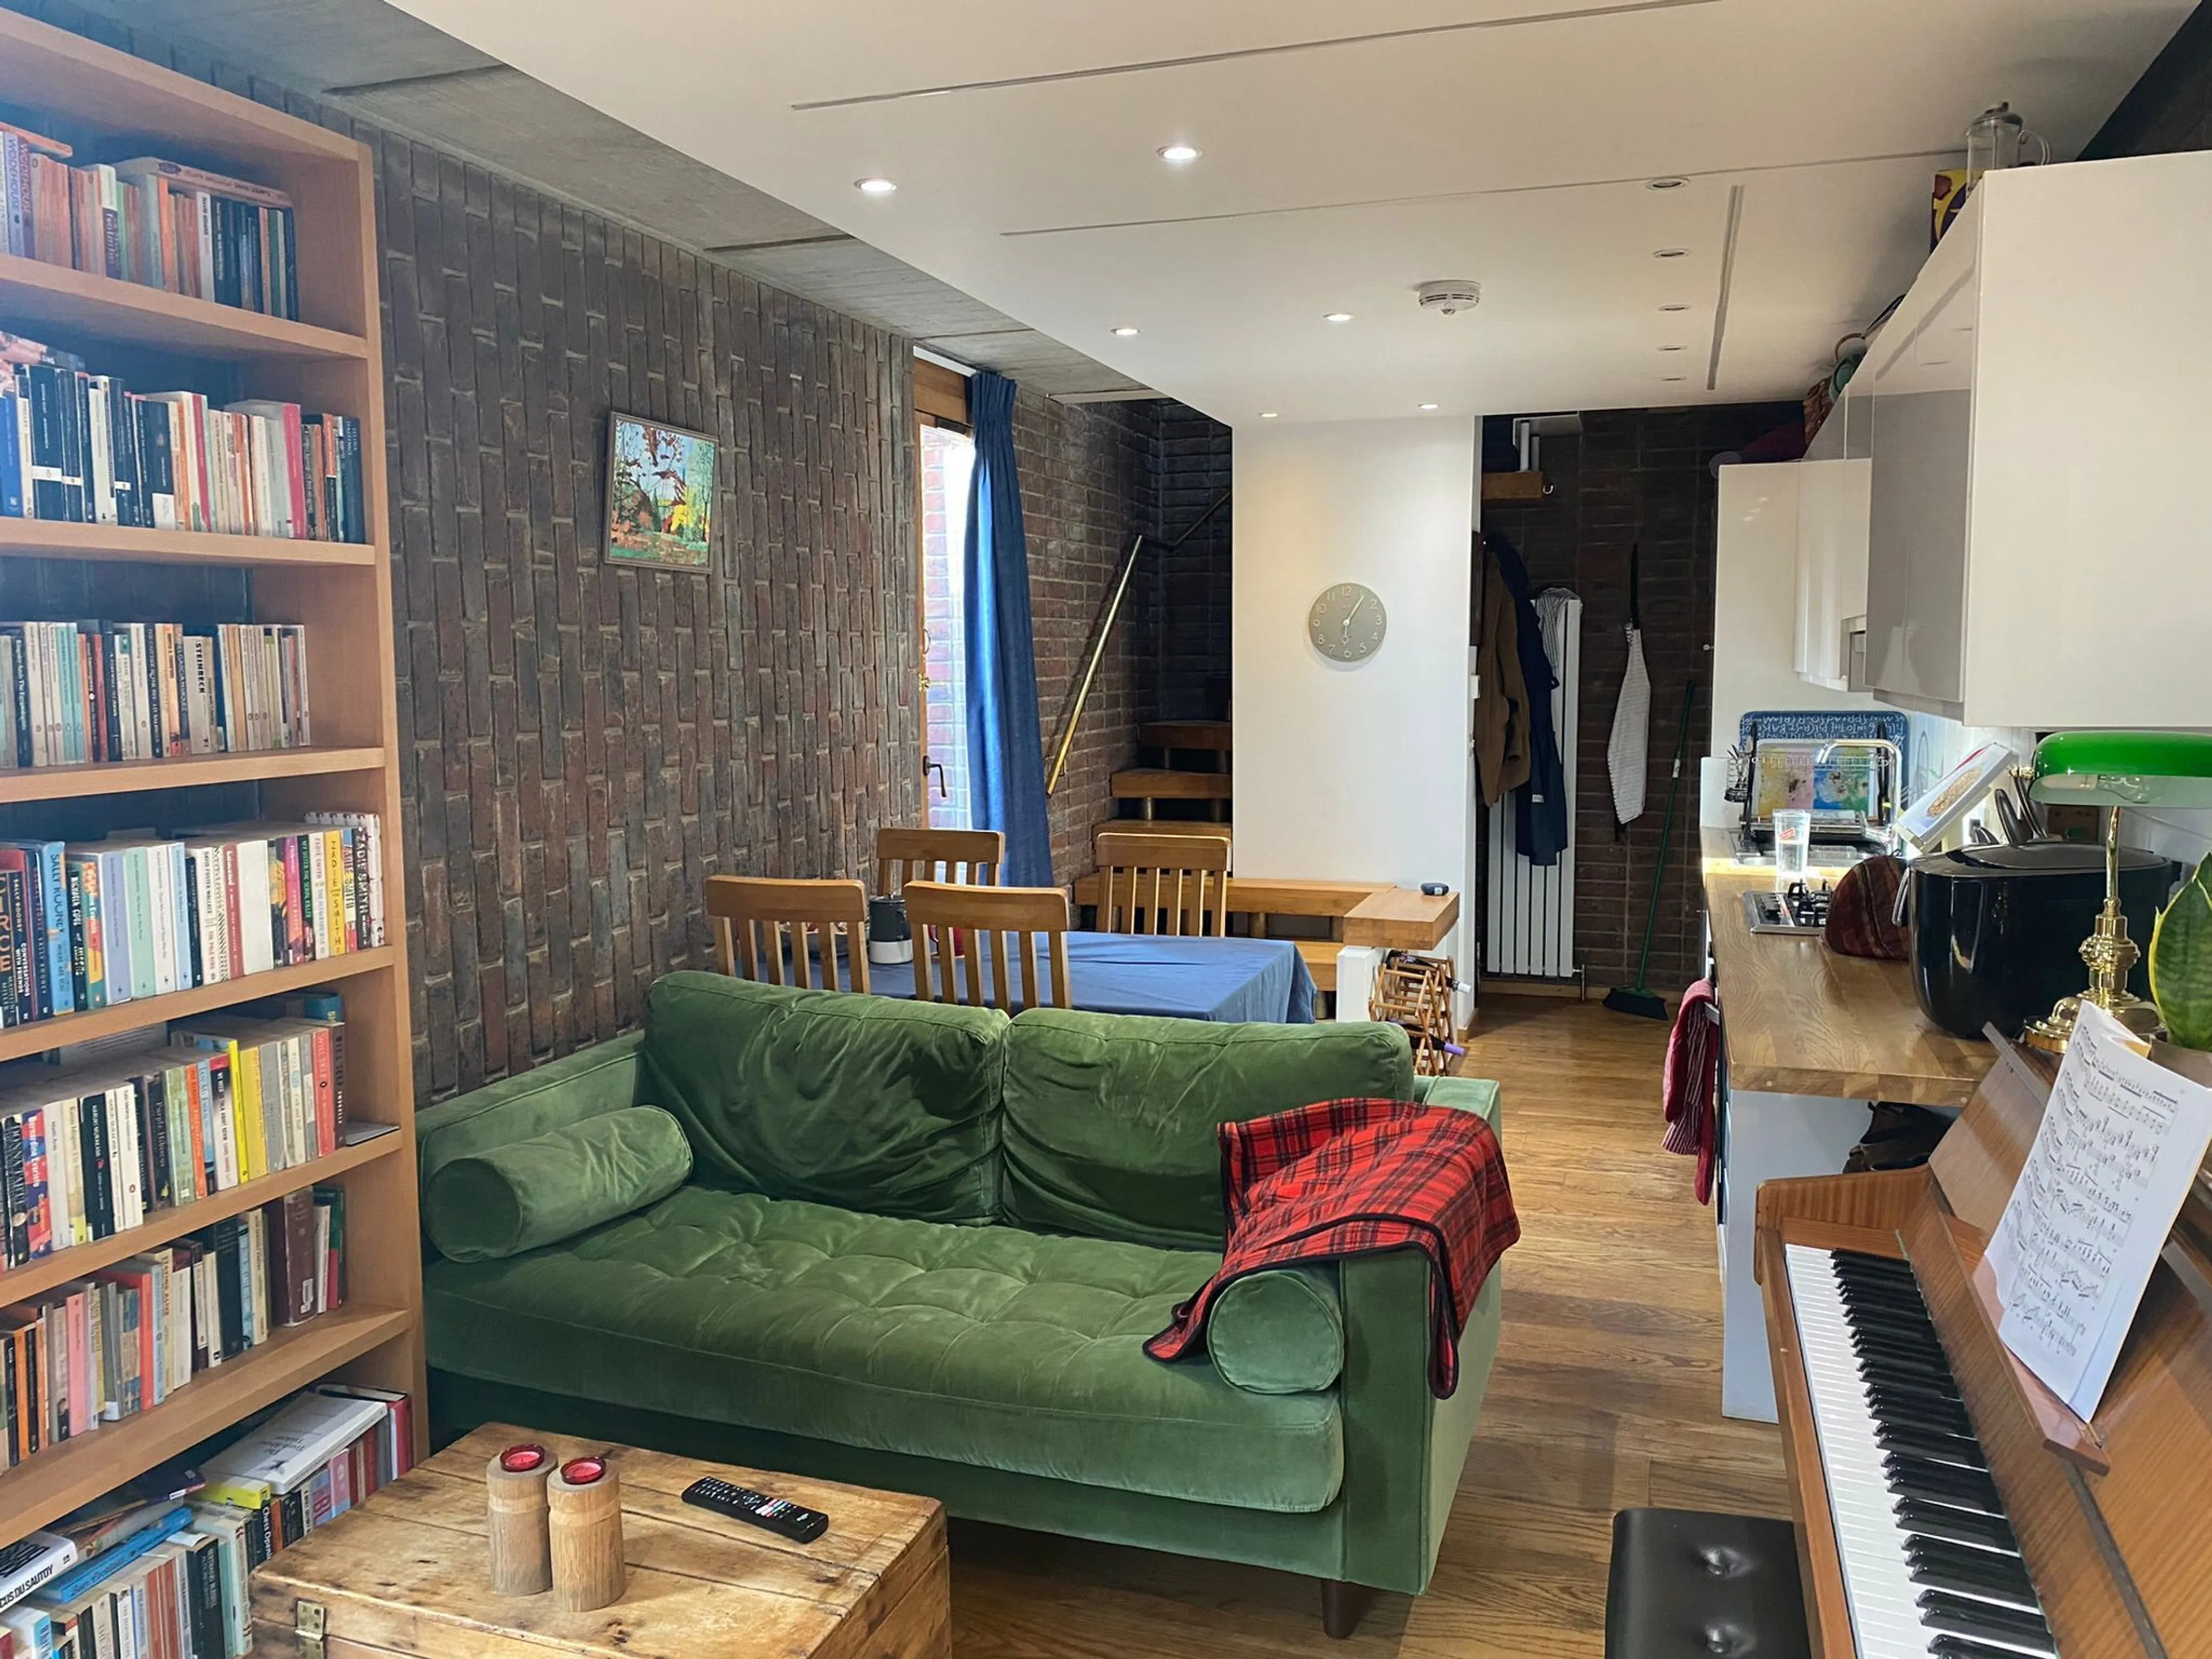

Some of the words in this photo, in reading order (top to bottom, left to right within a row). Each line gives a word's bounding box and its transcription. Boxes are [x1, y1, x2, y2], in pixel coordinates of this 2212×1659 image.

[8, 138, 21, 209] WODEHOUSE
[1327, 592, 1335, 601] 11
[1341, 586, 1352, 597] 12
[1370, 599, 1378, 609] 2
[1316, 603, 1327, 615] 10
[1375, 615, 1382, 625] 3
[1317, 634, 1325, 645] 8
[1329, 644, 1335, 654] 7
[1359, 642, 1366, 653] 5
[1372, 632, 1378, 641] 4
[1344, 649, 1352, 658] 6
[195, 642, 205, 694] STEINBECK
[1869, 722, 1904, 734] FILLG
[356, 835, 367, 870] ZADIE
[50, 854, 61, 883] SALLY
[358, 873, 369, 914] SMITH
[53, 887, 67, 933] ROONEY
[21, 943, 30, 997] CONVERSATIONS
[154, 1101, 164, 1128] Purple
[28, 1116, 39, 1156] Bernardine
[157, 1131, 166, 1167] Hibiscus
[31, 1158, 40, 1187] Evaristo
[262, 1506, 271, 1531] Chess
[264, 1532, 272, 1559] Openi
[14, 1583, 25, 1597] DU
[25, 1564, 54, 1591] SAUTOY
